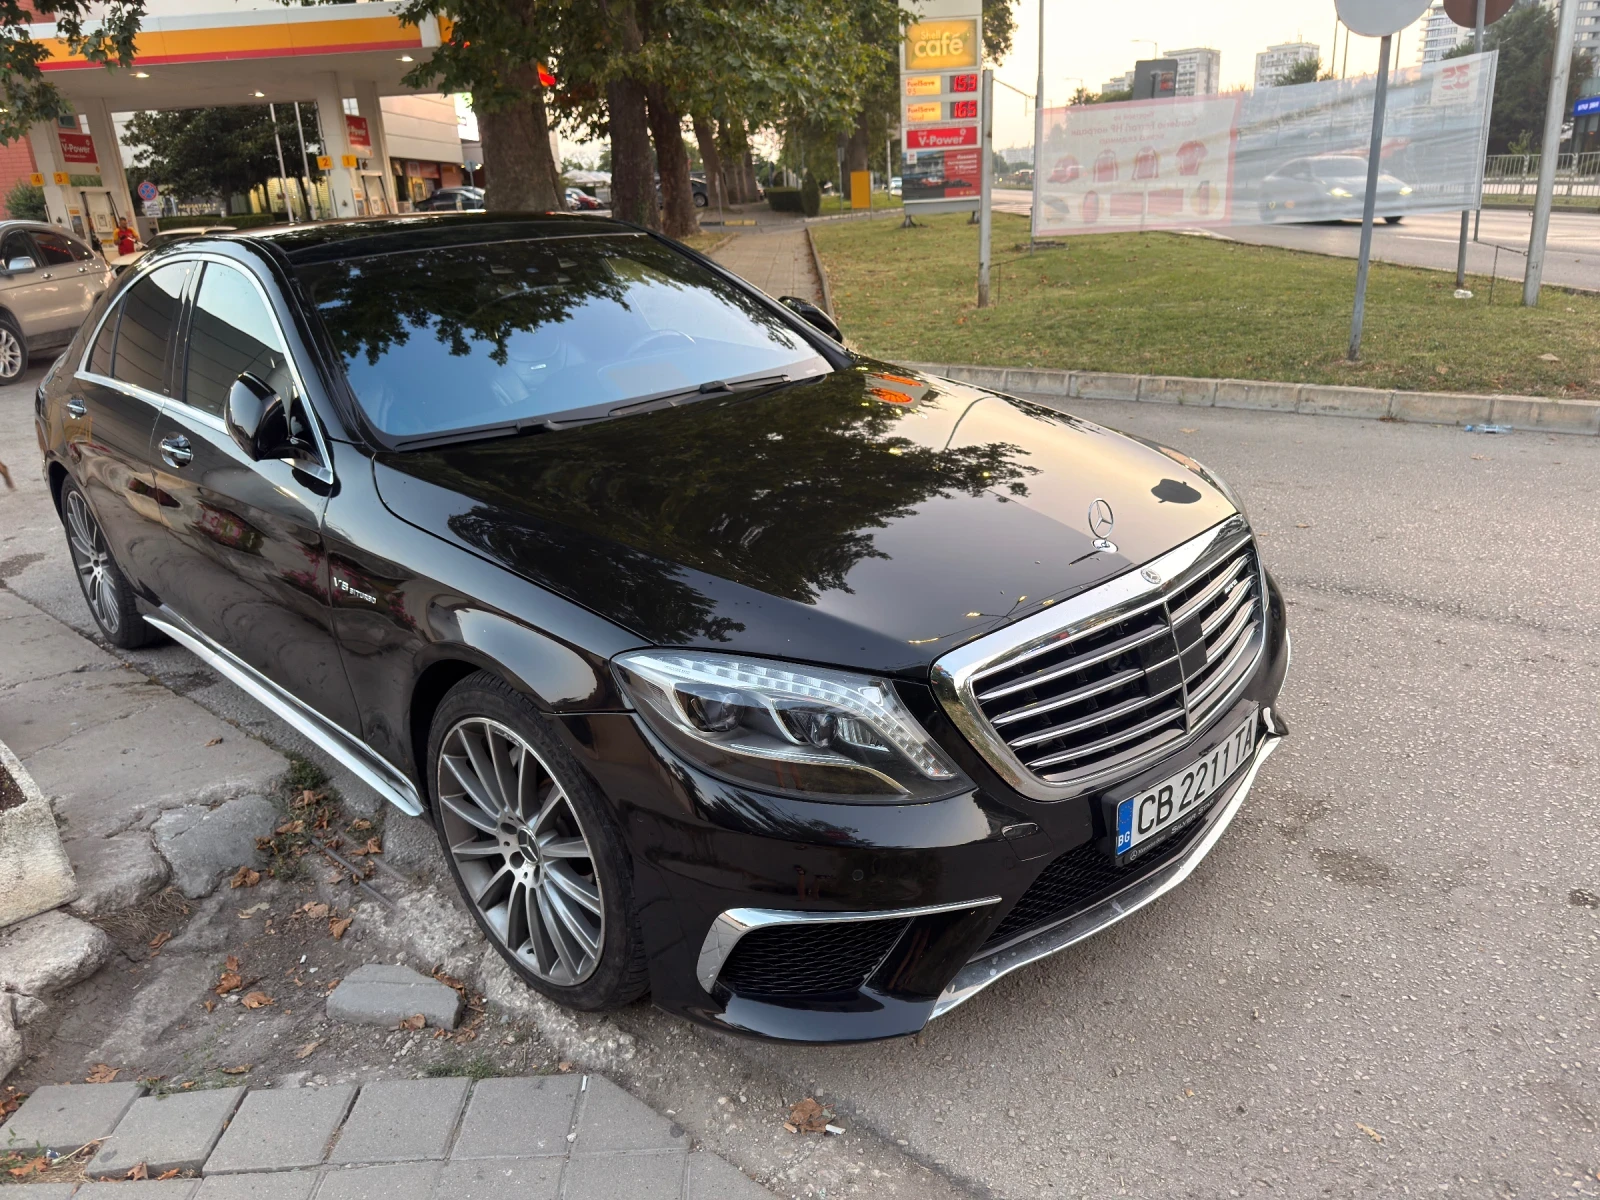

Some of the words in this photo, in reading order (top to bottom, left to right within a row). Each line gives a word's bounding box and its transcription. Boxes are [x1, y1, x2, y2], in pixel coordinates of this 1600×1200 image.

[920, 29, 941, 40] Shell
[914, 31, 964, 58] café
[907, 79, 935, 88] FuelSave
[918, 134, 964, 146] V-Power
[61, 143, 91, 154] V-Power
[333, 576, 349, 592] V8
[349, 587, 377, 604] BITURBO
[1137, 784, 1174, 835] CB
[1178, 741, 1231, 813] 2211
[1235, 718, 1253, 765] TA
[1118, 830, 1131, 848] BG
